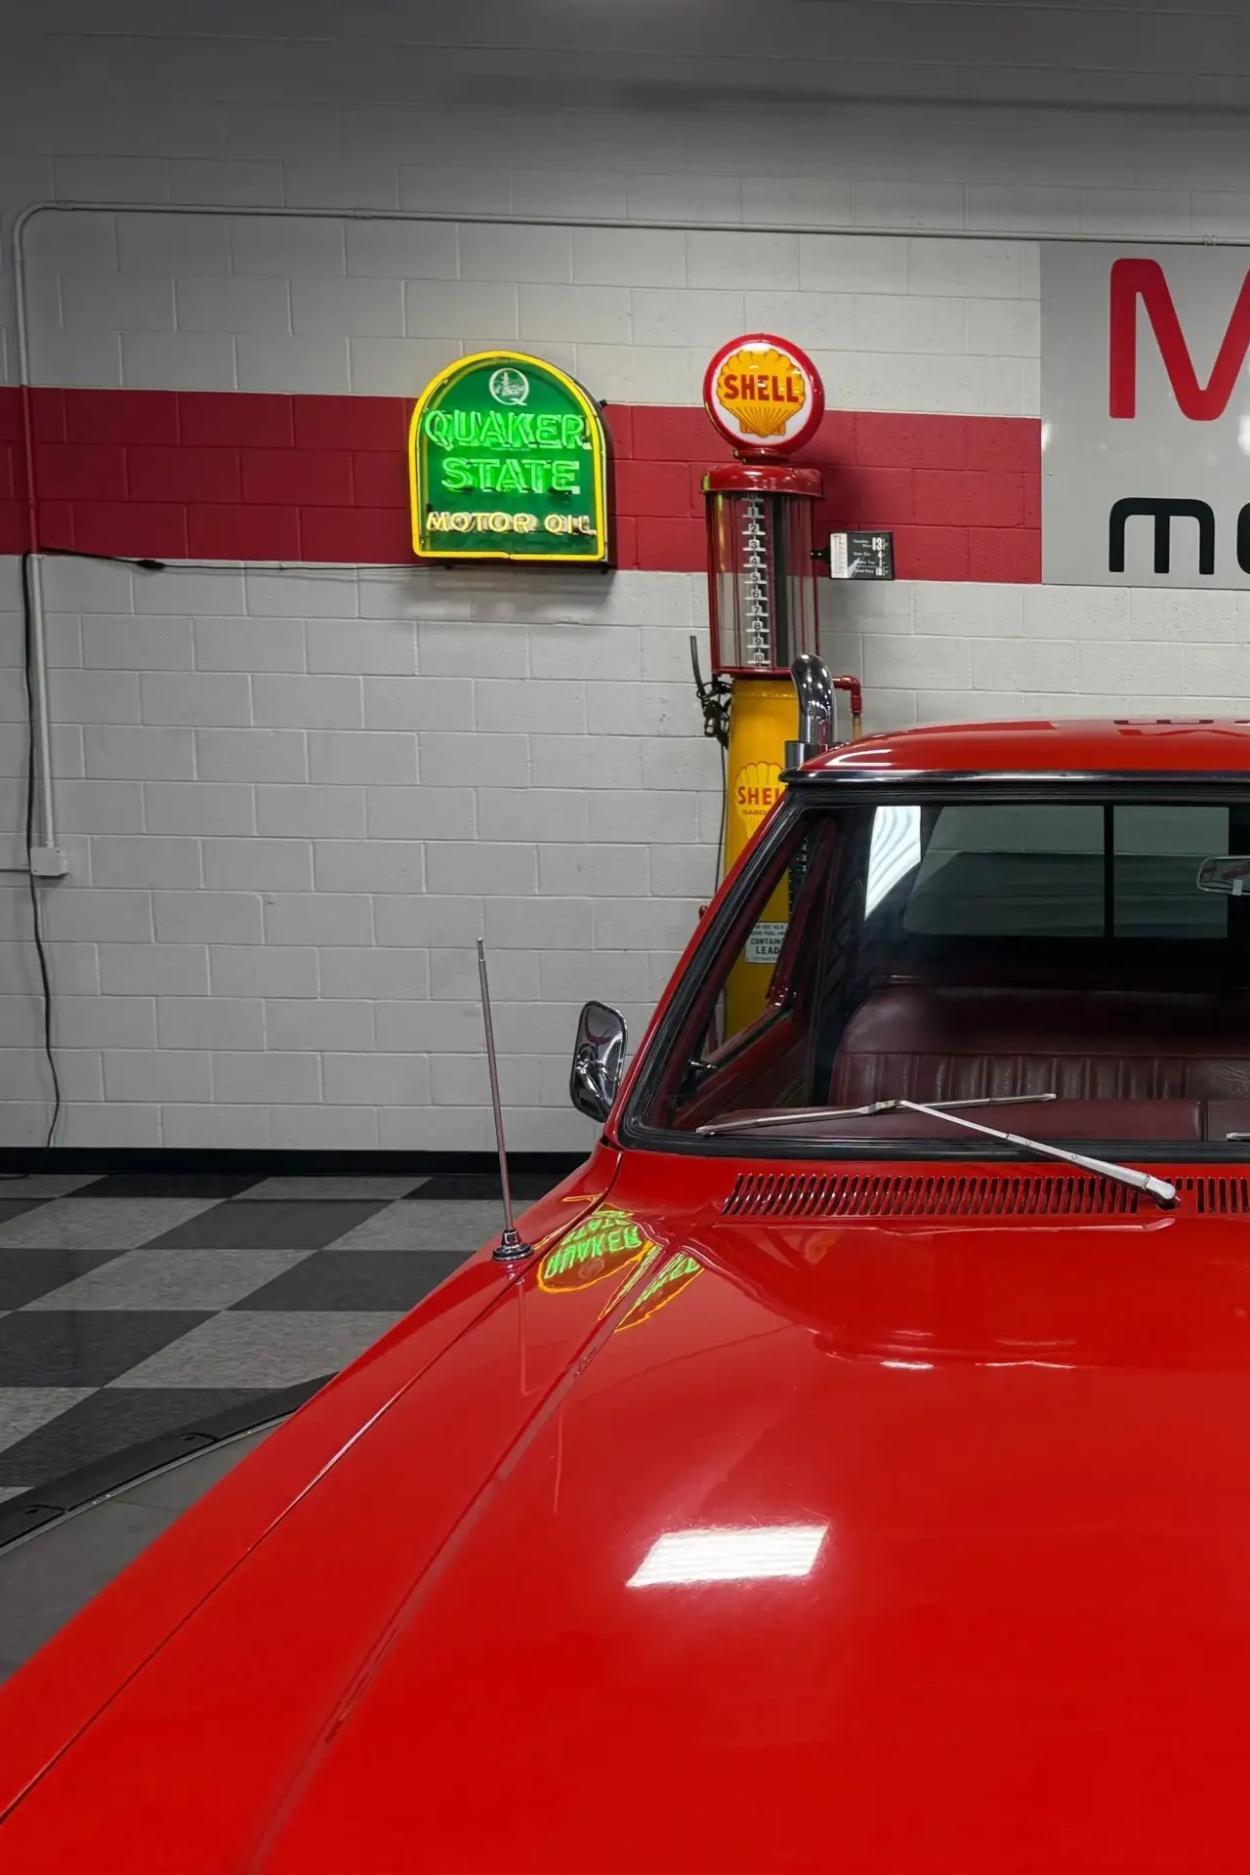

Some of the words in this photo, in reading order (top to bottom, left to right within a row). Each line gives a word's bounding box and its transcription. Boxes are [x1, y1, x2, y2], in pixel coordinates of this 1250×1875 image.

[724, 374, 799, 403] SHELL
[424, 409, 592, 451] QUAKER
[441, 457, 581, 495] STATE
[426, 511, 539, 533] MOTOR
[544, 513, 597, 536] OIL
[756, 945, 779, 955] LEAD
